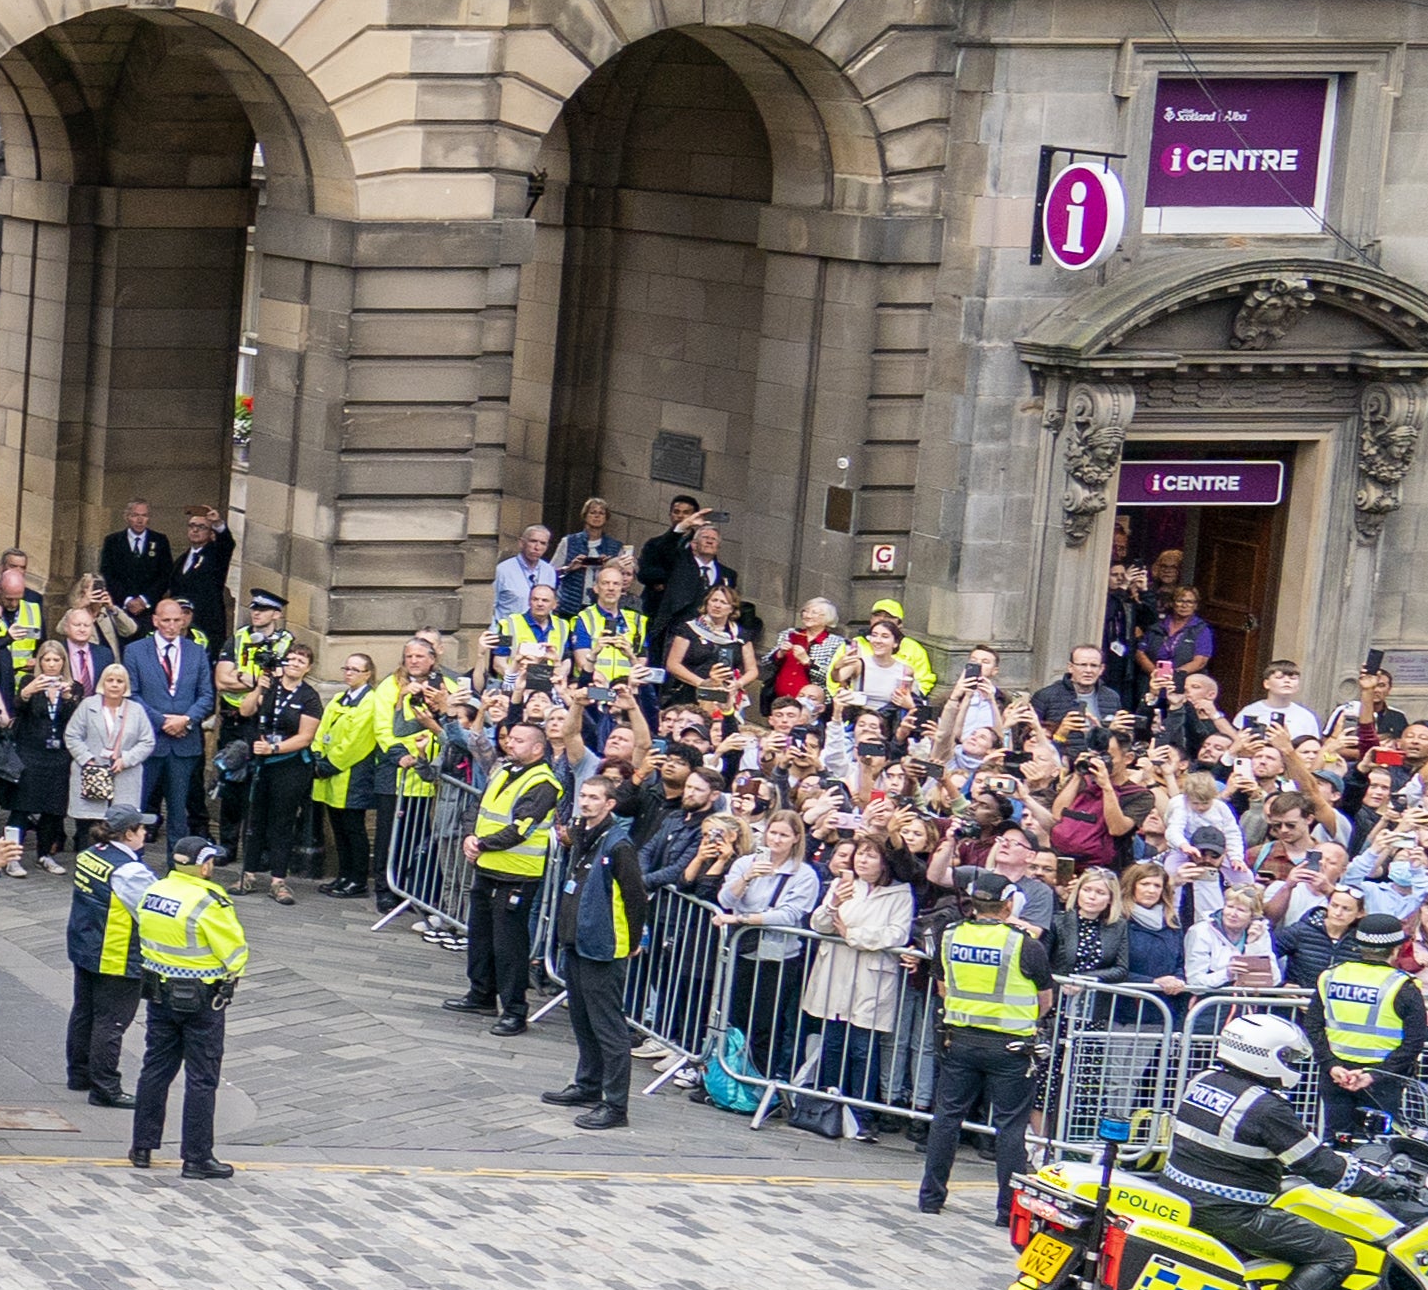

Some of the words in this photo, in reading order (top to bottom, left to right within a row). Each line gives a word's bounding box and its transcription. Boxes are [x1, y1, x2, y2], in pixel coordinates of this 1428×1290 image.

[1176, 110, 1216, 122] Scotland
[1170, 148, 1182, 171] i
[1186, 149, 1299, 172] CENTRE
[1151, 474, 1161, 491] i
[1162, 475, 1241, 492] CENTRE
[876, 546, 892, 563] G
[144, 895, 180, 916] POLICE
[951, 945, 999, 964] POLICE
[1328, 983, 1378, 1003] POLICE
[1117, 1190, 1181, 1222] POLICE
[1032, 1237, 1066, 1262] LG21
[1025, 1253, 1053, 1277] VNZ
